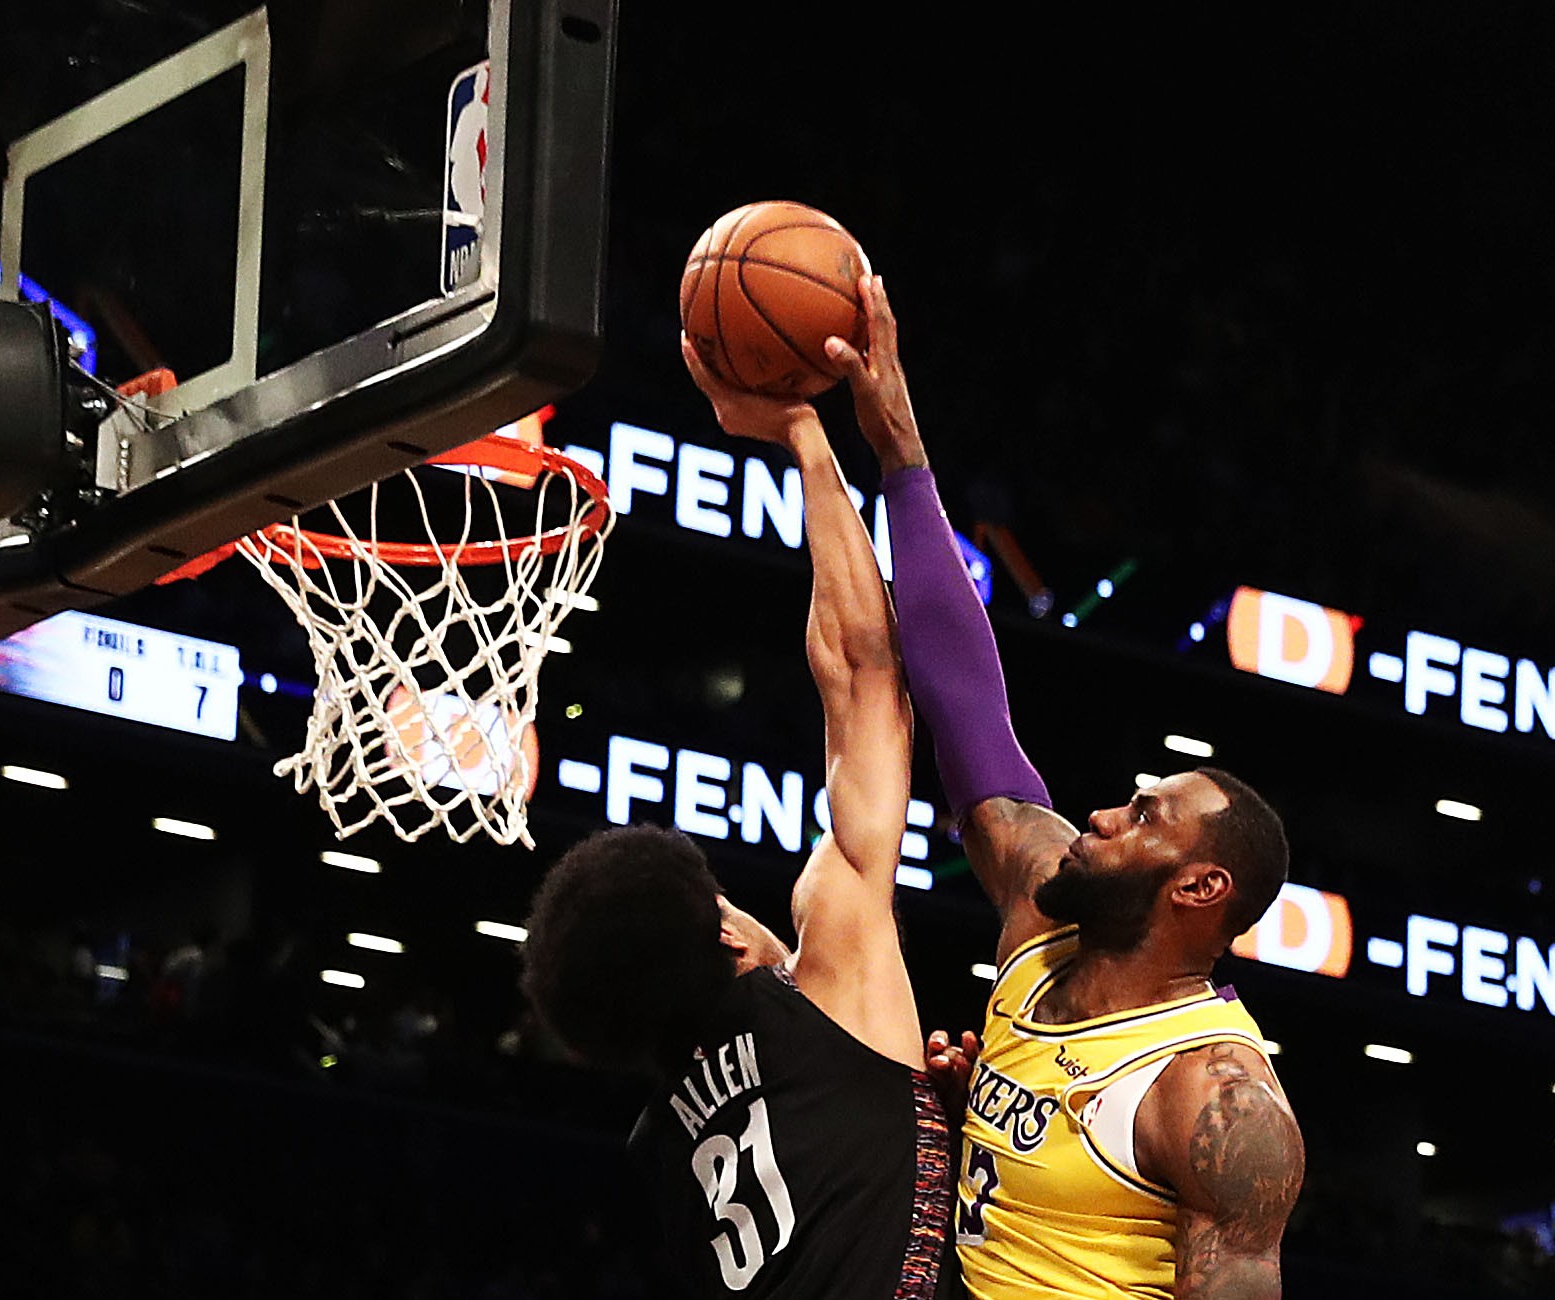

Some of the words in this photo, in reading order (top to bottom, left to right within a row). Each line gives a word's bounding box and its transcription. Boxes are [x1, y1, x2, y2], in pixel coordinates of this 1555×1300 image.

[562, 421, 895, 582] -FEN
[1257, 591, 1334, 689] D
[195, 685, 208, 720] 7
[558, 734, 935, 891] -FENE
[1256, 882, 1333, 974] D
[668, 1032, 762, 1140] ALLEN
[968, 1062, 1062, 1154] KERS
[691, 1097, 795, 1291] 31
